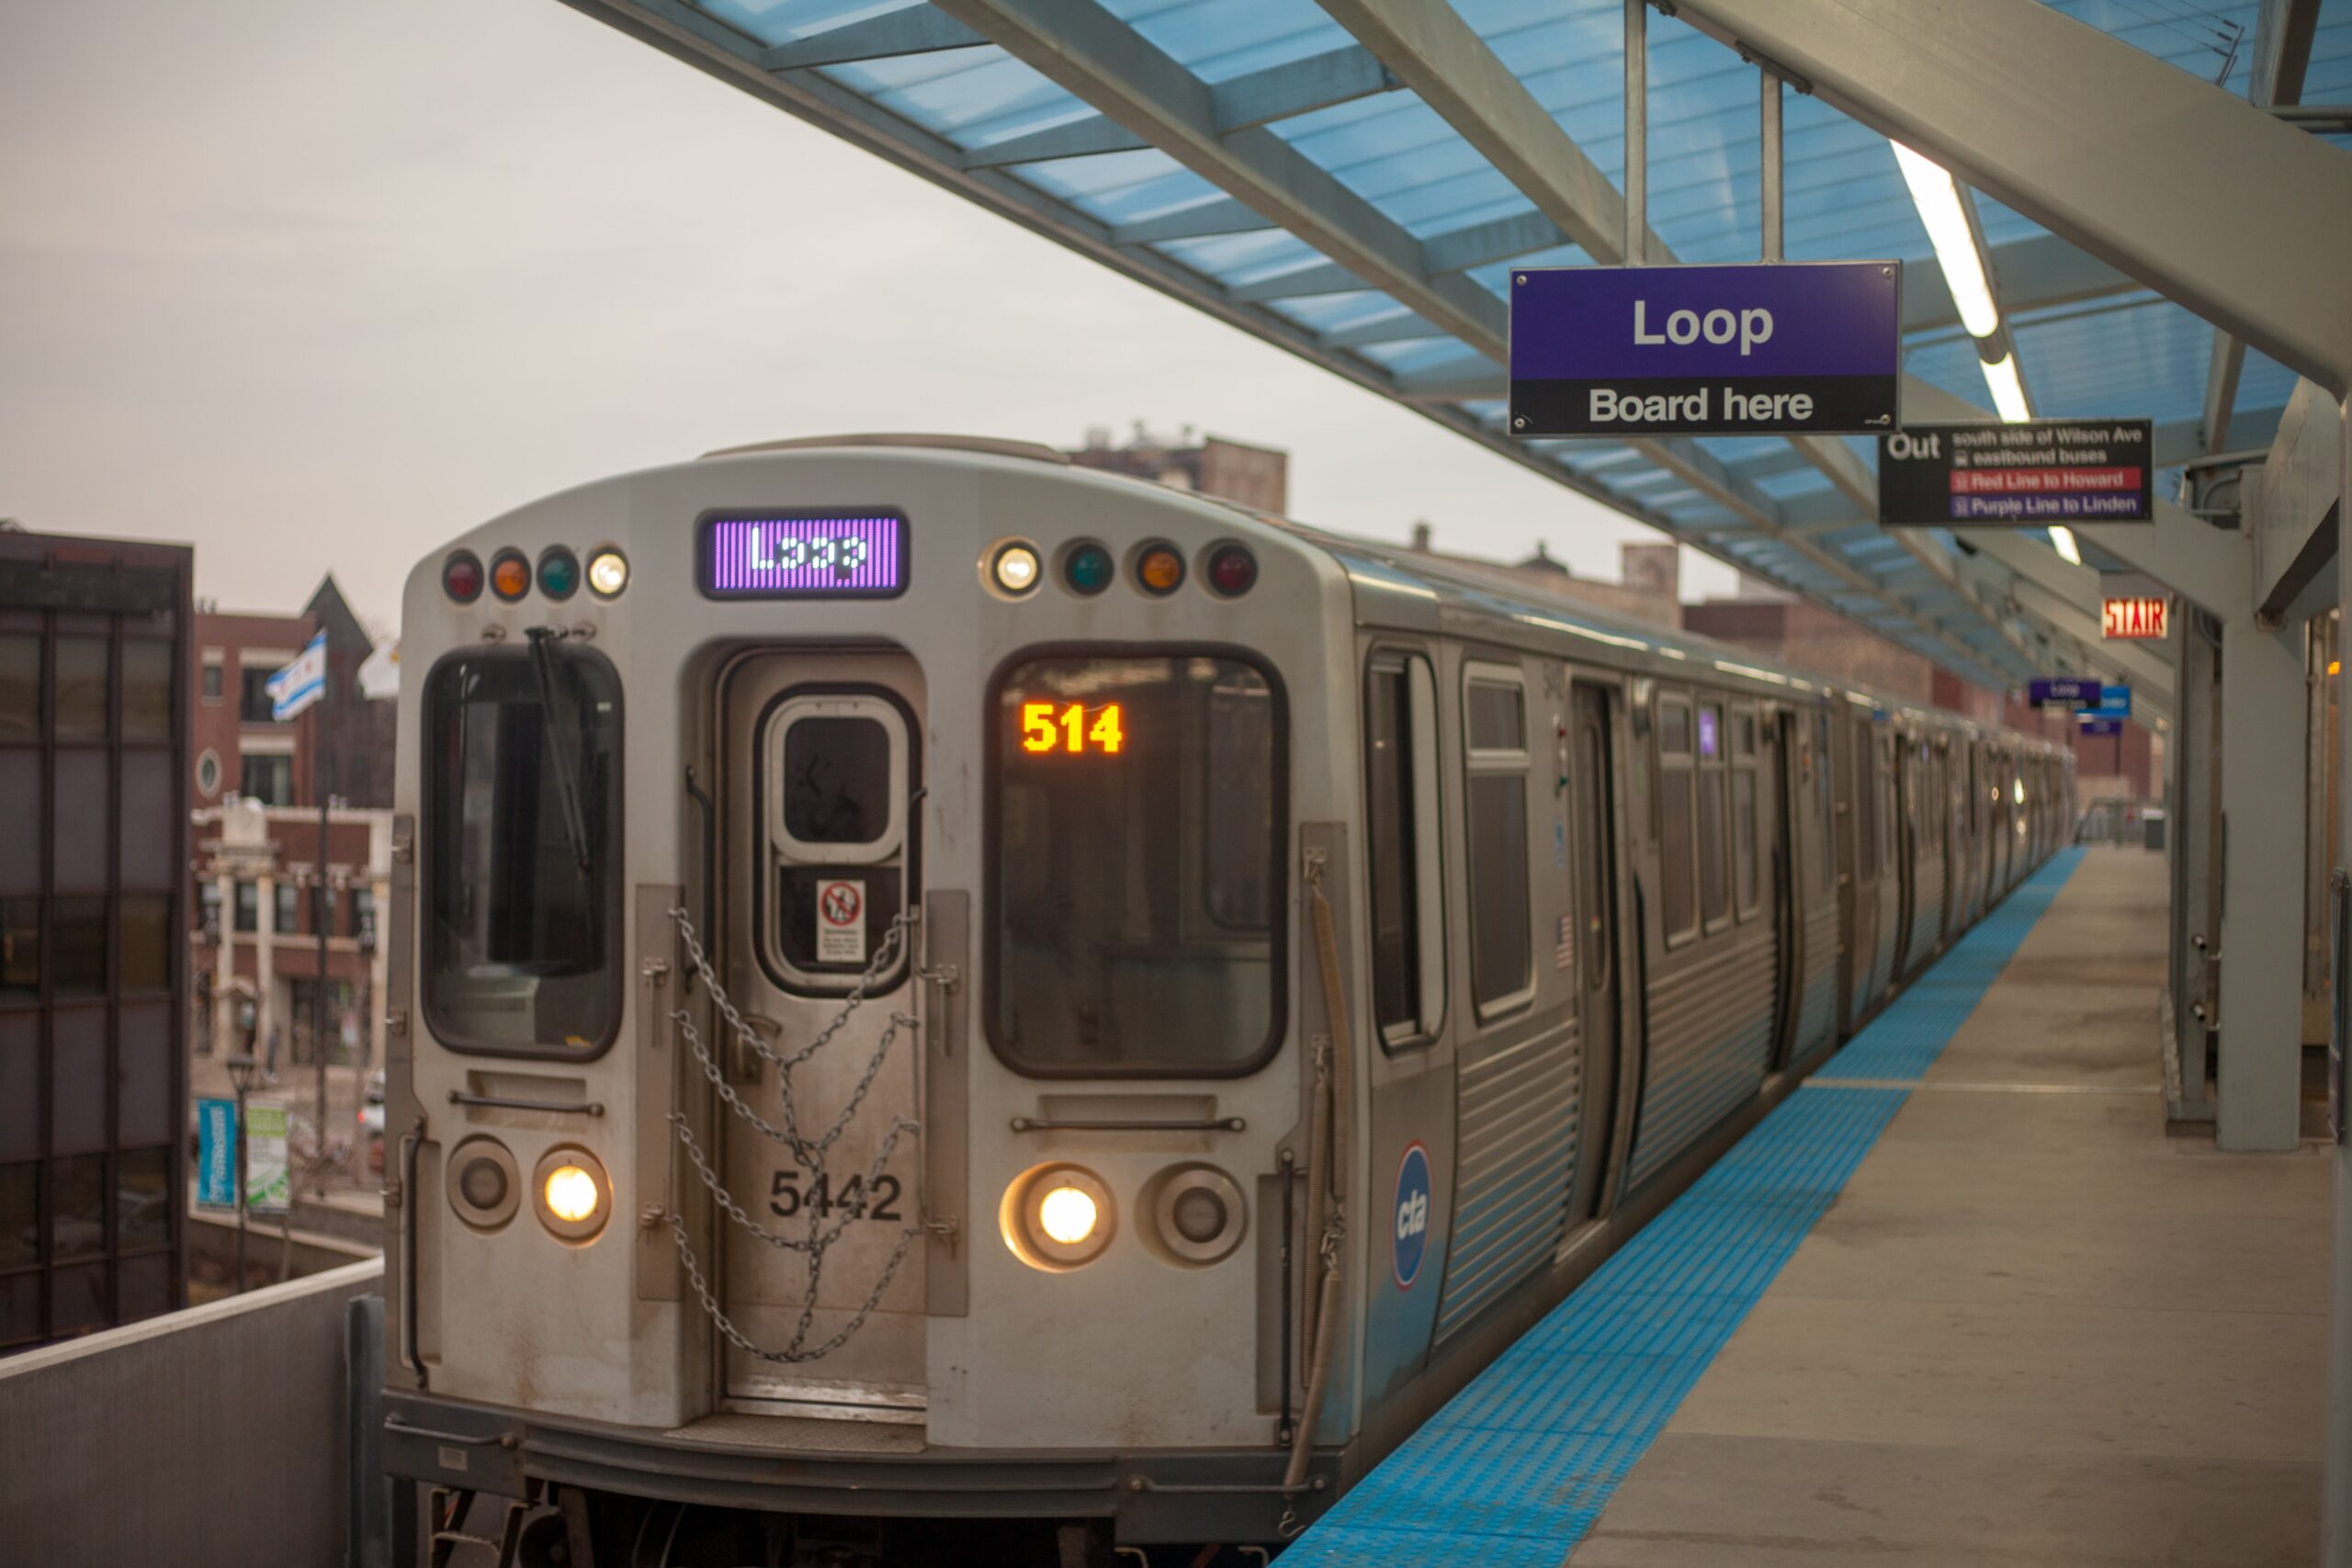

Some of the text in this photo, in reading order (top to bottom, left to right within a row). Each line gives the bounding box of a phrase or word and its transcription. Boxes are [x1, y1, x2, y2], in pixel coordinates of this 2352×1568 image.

[1634, 299, 1774, 356] Loop
[1589, 387, 1814, 423] Board here
[1887, 432, 1940, 459] Out
[1952, 426, 2143, 447] south side of Wilson Ave
[1973, 447, 2108, 467] eastbound buses
[1972, 470, 2123, 491] Red Line to Howard
[1971, 495, 2137, 517] Purple Line to Linden
[2106, 596, 2164, 635] STAIR
[1023, 704, 1123, 752] 514
[770, 1171, 901, 1221] 5442
[1397, 1190, 1427, 1239] cta
